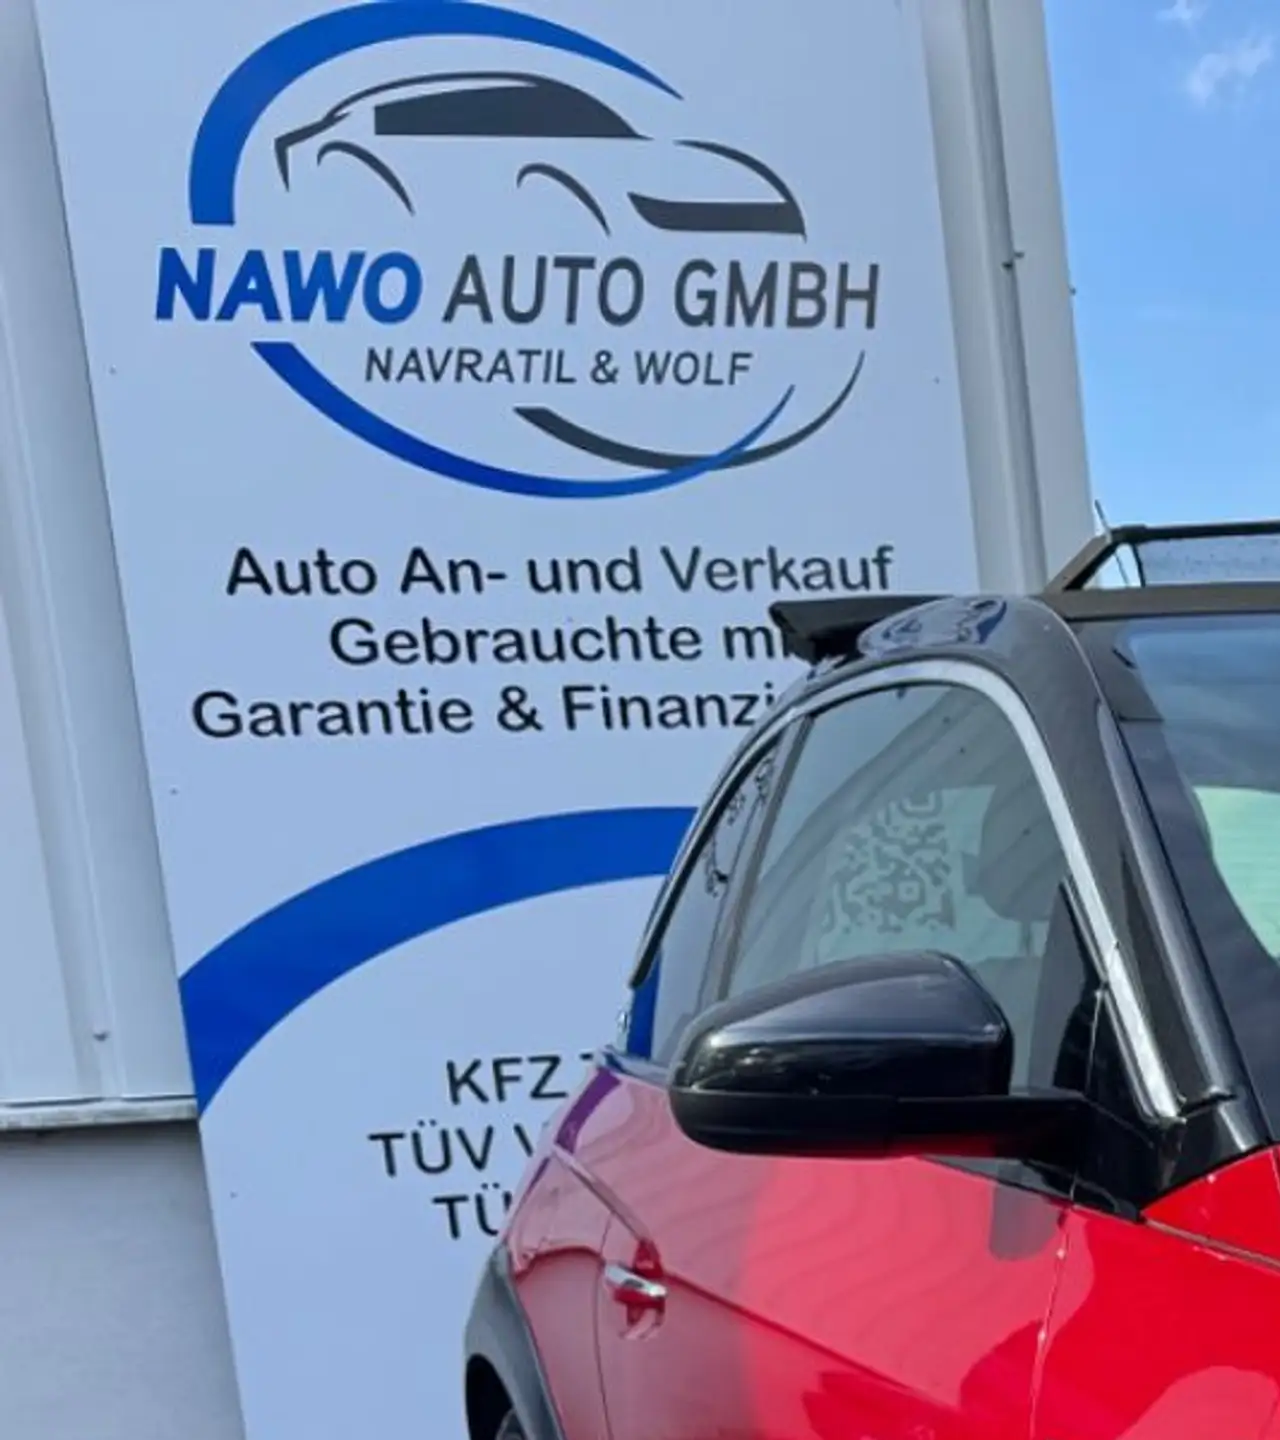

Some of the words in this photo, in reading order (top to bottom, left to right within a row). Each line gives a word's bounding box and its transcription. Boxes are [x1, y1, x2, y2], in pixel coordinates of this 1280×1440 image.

[155, 247, 422, 323] NAWO
[441, 255, 645, 326] AUTO
[674, 260, 879, 330] GMBH
[364, 346, 577, 385] NAVRATIL
[589, 349, 619, 385] &
[635, 351, 754, 386] WOLF
[226, 547, 377, 597] Auto
[400, 545, 507, 596] An-
[527, 547, 641, 595] und
[660, 545, 894, 593] Verkauf
[329, 613, 702, 666] Gebrauchte
[191, 687, 473, 739] Garantie
[495, 687, 544, 732] &
[446, 1054, 569, 1106] KFZ
[367, 1119, 494, 1178] TÜV
